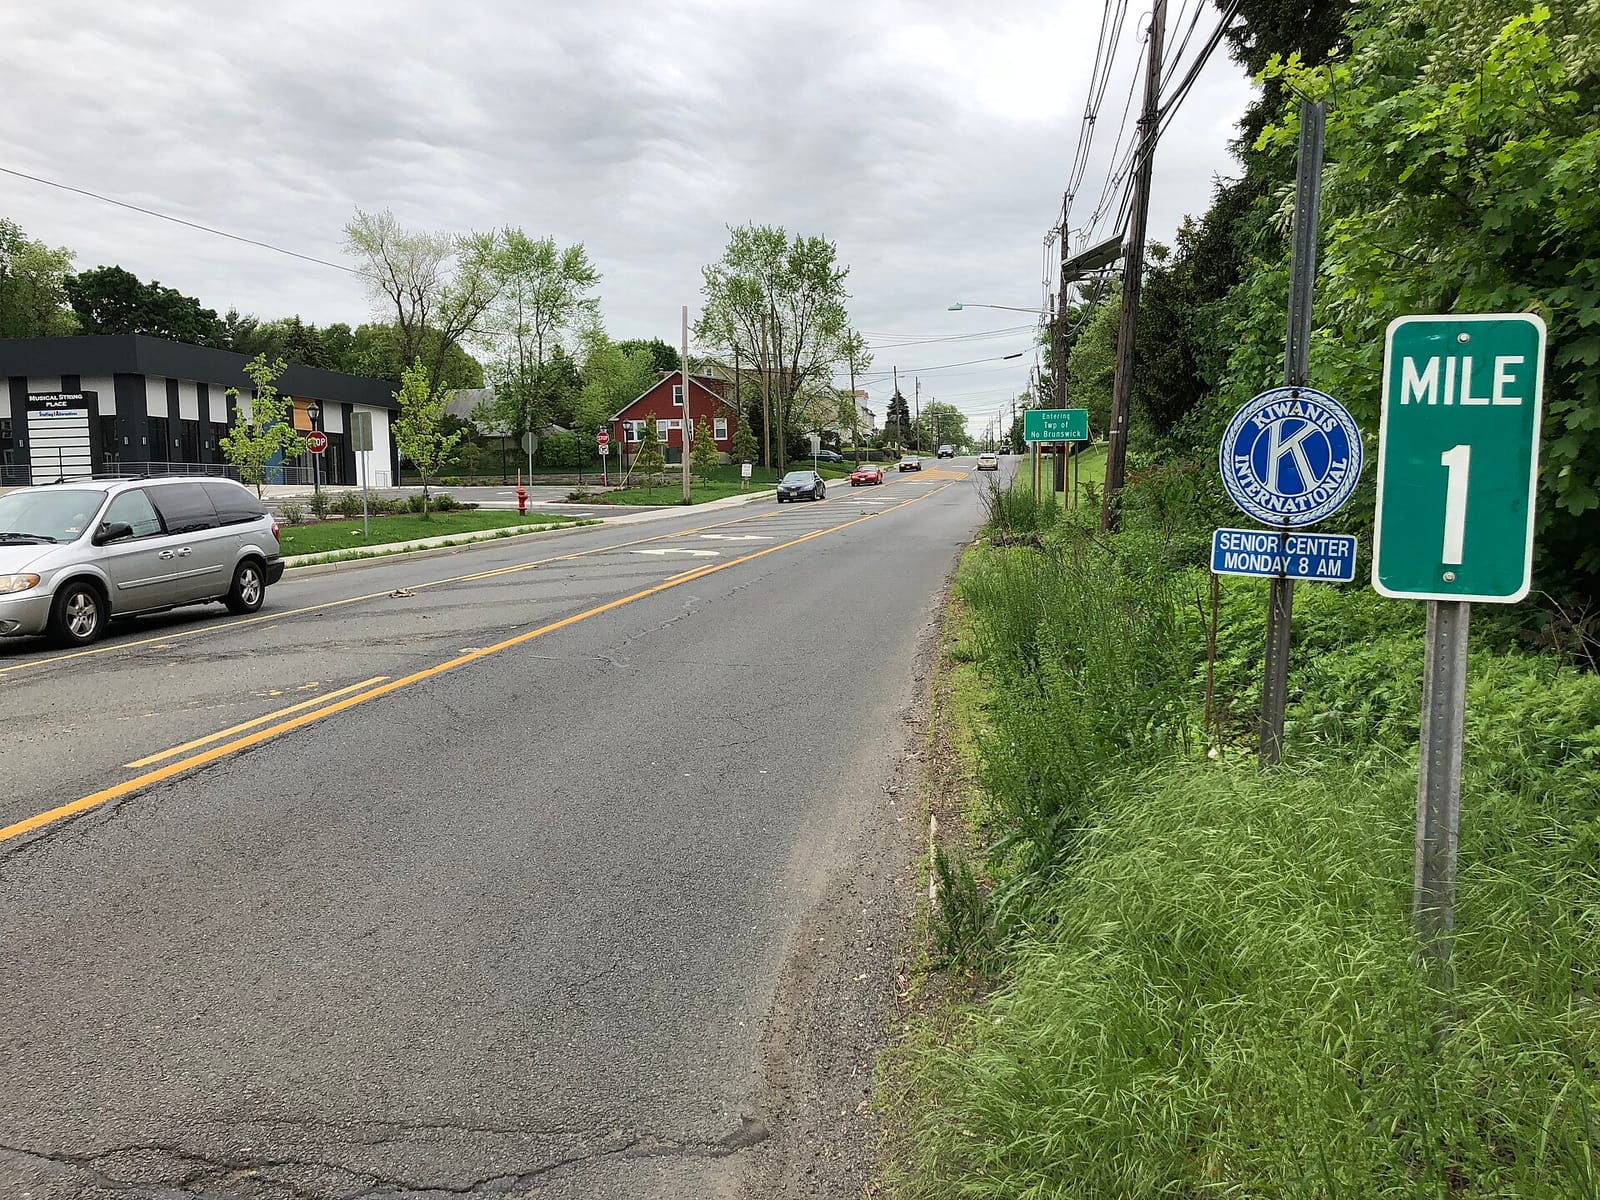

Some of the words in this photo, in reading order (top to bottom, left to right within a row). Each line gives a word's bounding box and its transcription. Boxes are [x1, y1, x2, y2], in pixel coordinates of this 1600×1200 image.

[1400, 356, 1525, 405] MILE
[1044, 421, 1057, 430] Twp
[1252, 401, 1338, 432] KIWANIS
[1043, 430, 1081, 438] Brunswick
[1263, 419, 1321, 495] K
[1235, 454, 1348, 512] INTERNATIONAL
[1441, 444, 1471, 564] 1
[1220, 533, 1278, 553] SENIOR
[1285, 537, 1349, 557] CENTER
[1224, 552, 1291, 573] MONDAY
[1298, 557, 1309, 574] 8
[1316, 559, 1342, 576] AM
